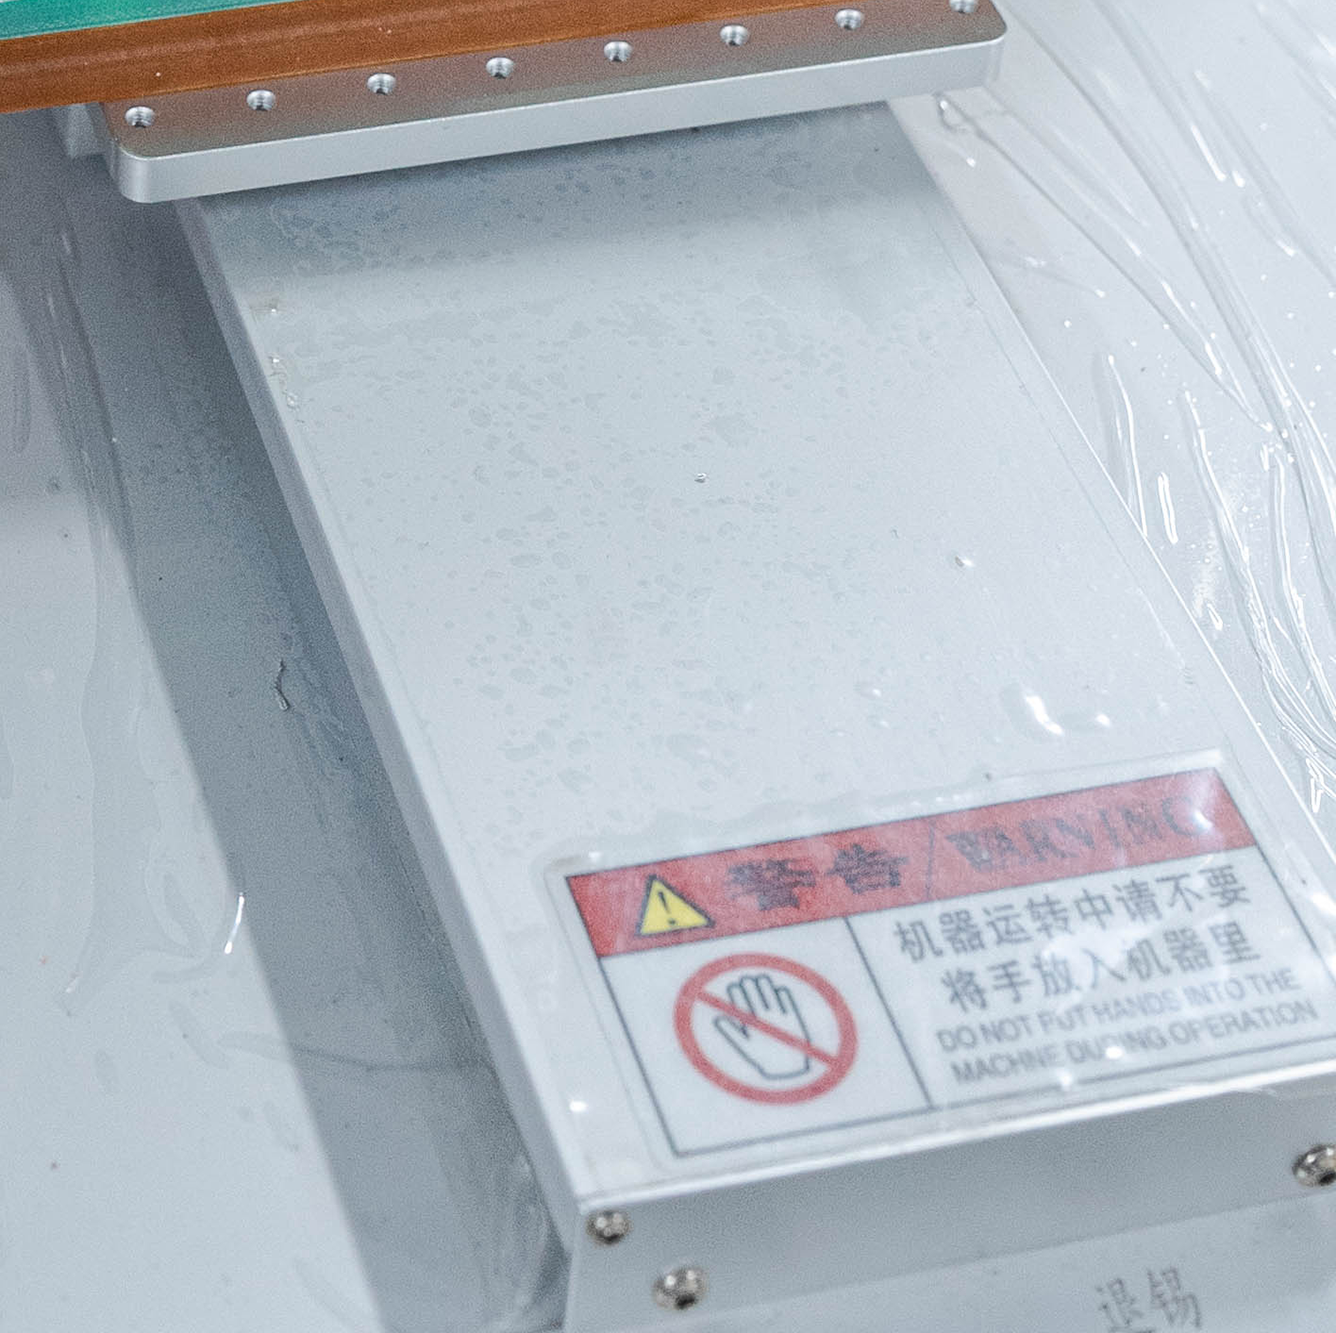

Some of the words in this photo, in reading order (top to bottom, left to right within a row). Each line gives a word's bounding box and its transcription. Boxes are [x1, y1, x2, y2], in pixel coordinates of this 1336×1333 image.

[895, 864, 1251, 963] 机器运转中请不要
[936, 1025, 977, 1053] DO
[979, 1014, 1033, 1044] NOT
[1035, 1003, 1088, 1035] PUT
[1091, 988, 1181, 1024] HANDS
[1183, 976, 1246, 1006] INTO
[1245, 967, 1301, 995] THE
[940, 920, 1261, 1013] 将手放入机器里
[950, 1044, 1061, 1085] MACHINE
[1168, 998, 1319, 1046] OPERATION
